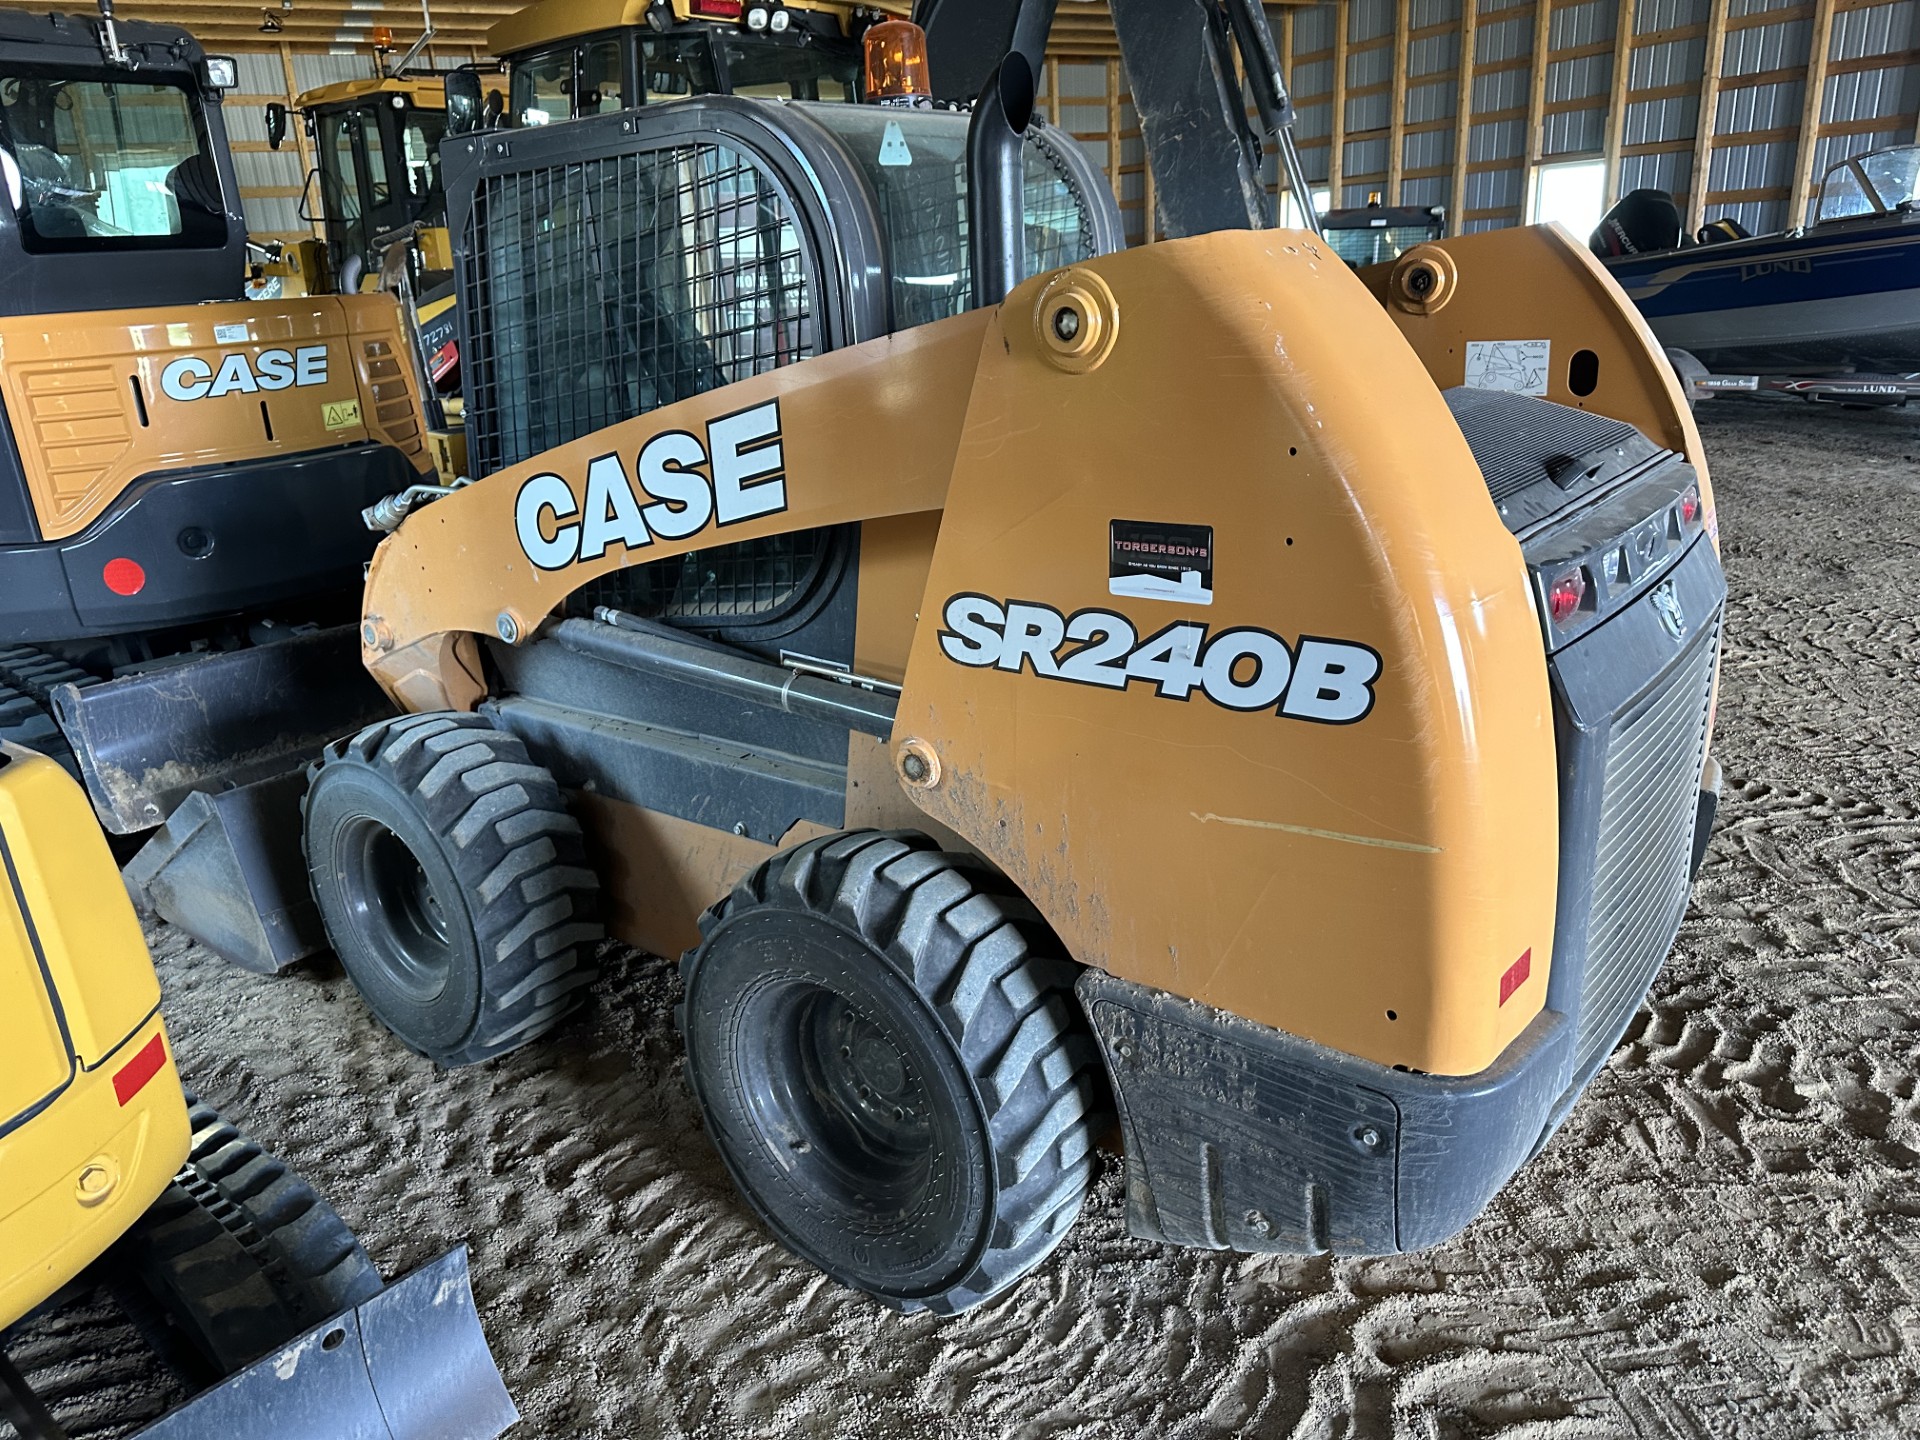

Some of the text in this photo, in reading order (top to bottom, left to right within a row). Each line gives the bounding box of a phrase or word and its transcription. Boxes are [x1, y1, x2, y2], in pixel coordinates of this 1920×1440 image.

[1607, 218, 1639, 255] MERCUR
[1741, 257, 1812, 281] LUND
[160, 344, 328, 402] CASE
[1863, 384, 1897, 393] LUND
[514, 396, 788, 571] CASE
[1114, 540, 1208, 558] TORGERSON'S
[937, 591, 1383, 725] SR240B
